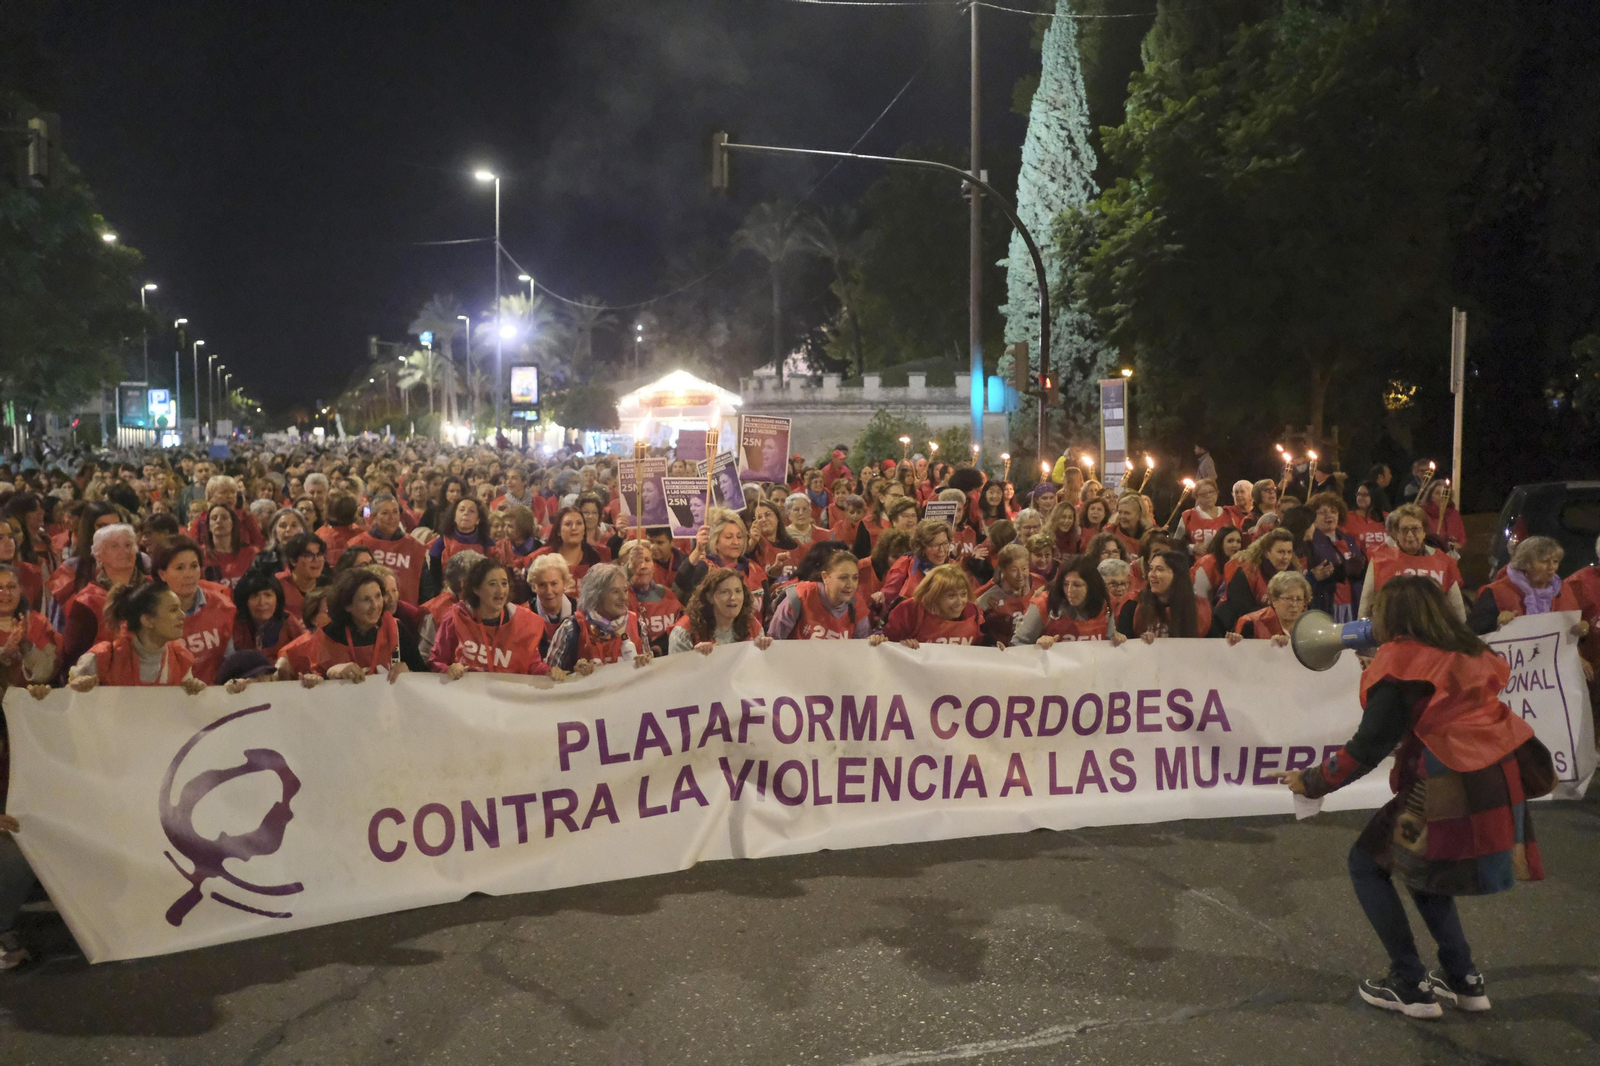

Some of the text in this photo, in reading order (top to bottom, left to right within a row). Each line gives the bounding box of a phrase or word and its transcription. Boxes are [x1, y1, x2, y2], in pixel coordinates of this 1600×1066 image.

[743, 437, 762, 446] 25N
[668, 498, 688, 506] 25N
[373, 550, 411, 569] 25N
[462, 640, 512, 668] 25N
[557, 688, 1232, 771] PLATAFORMA CORDOBESA
[368, 782, 620, 862] CONTRA
[637, 764, 710, 818] LA
[718, 754, 988, 806] VIOLENCIA
[999, 752, 1033, 797] A
[1048, 748, 1137, 795] LAS
